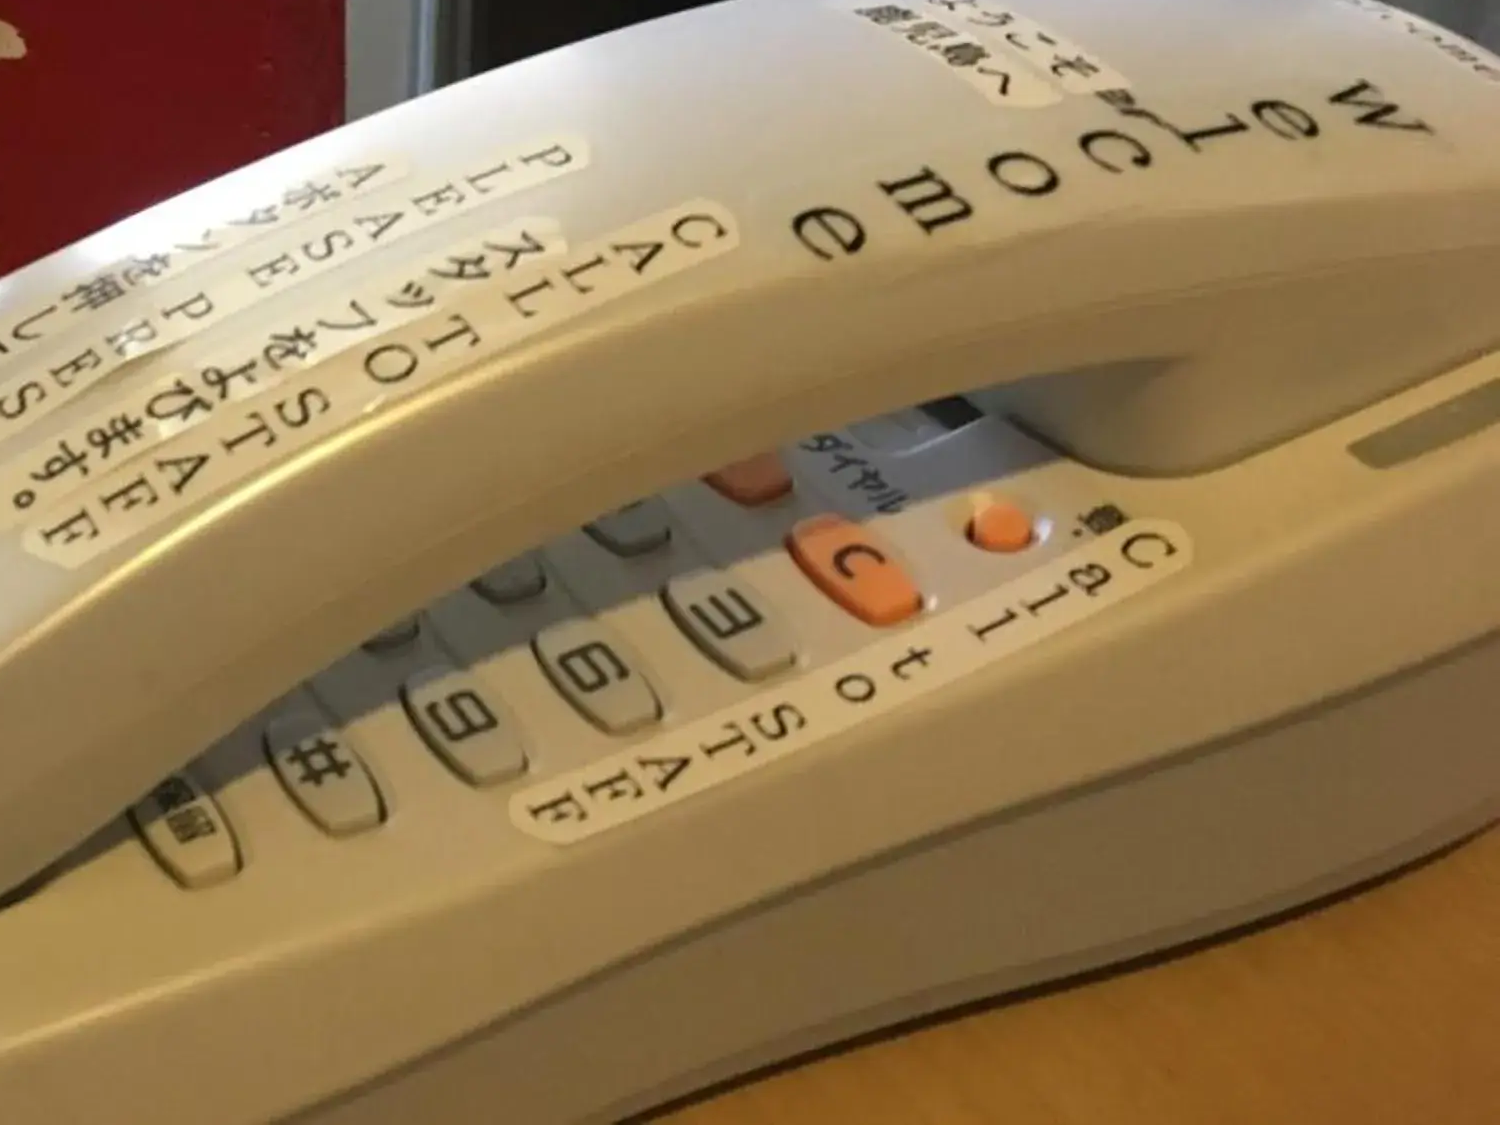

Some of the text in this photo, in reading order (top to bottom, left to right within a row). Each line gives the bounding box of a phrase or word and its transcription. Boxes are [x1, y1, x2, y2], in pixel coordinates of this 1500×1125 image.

[247, 143, 574, 289] PLEASE
[41, 212, 729, 548] CALL TO STAFF
[798, 433, 908, 513] ダイヤル
[831, 542, 886, 580] C
[688, 586, 764, 641] 3
[528, 531, 1178, 826] Call to STAFF
[557, 639, 631, 694] 6
[425, 689, 499, 743] 9
